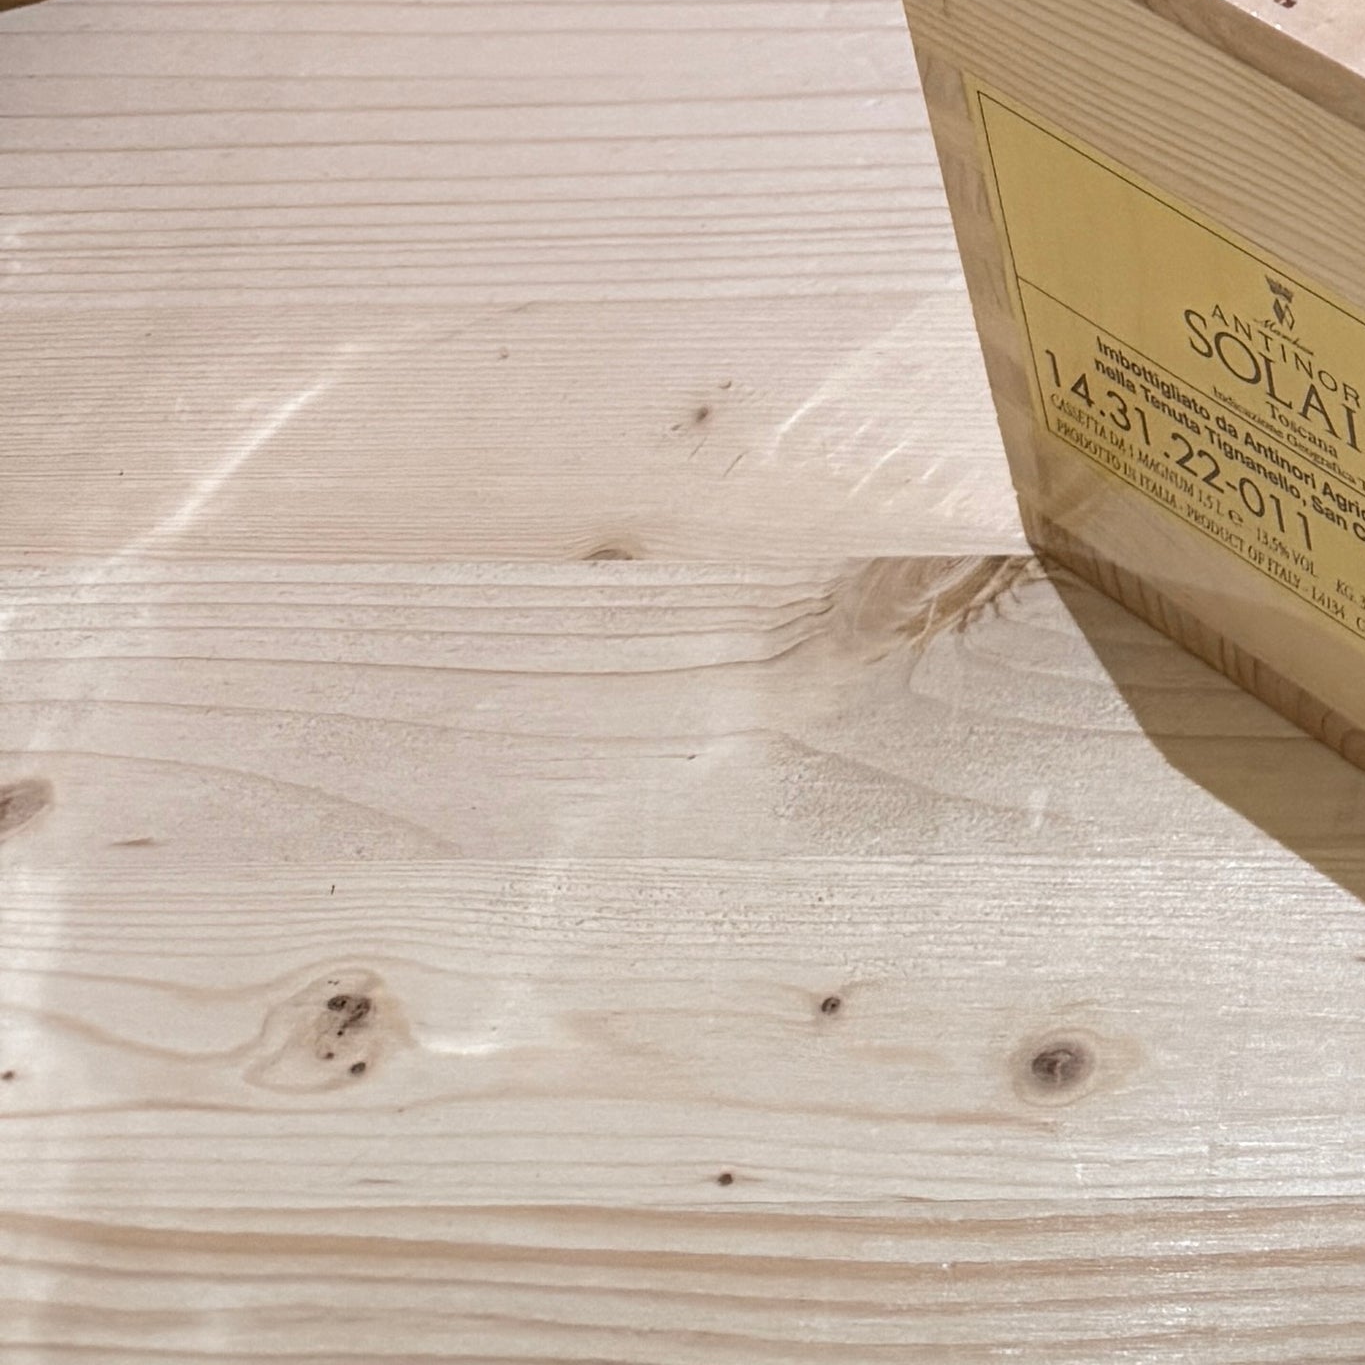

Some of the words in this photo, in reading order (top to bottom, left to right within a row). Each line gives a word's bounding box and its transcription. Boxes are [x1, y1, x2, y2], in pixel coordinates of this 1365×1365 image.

[1049, 392, 1108, 440] CASSETTA
[1108, 429, 1127, 454] DA
[1136, 447, 1195, 498] MAGNUM
[1290, 548, 1318, 578] VOL
[1092, 356, 1137, 395] nella
[1138, 382, 1202, 436] Tenuta
[1202, 423, 1307, 508] Tignanello,
[1309, 493, 1348, 532] San
[1095, 334, 1211, 422] Imbottigliato
[1213, 414, 1239, 440] da
[1242, 430, 1317, 490] Antinori
[1264, 399, 1339, 460] Toscana
[1055, 416, 1122, 471] PRODOTTO
[1138, 471, 1178, 509] ITALIA
[1185, 502, 1246, 553] PRODUCT
[1246, 543, 1265, 566] OF
[1266, 555, 1301, 590] ITALY
